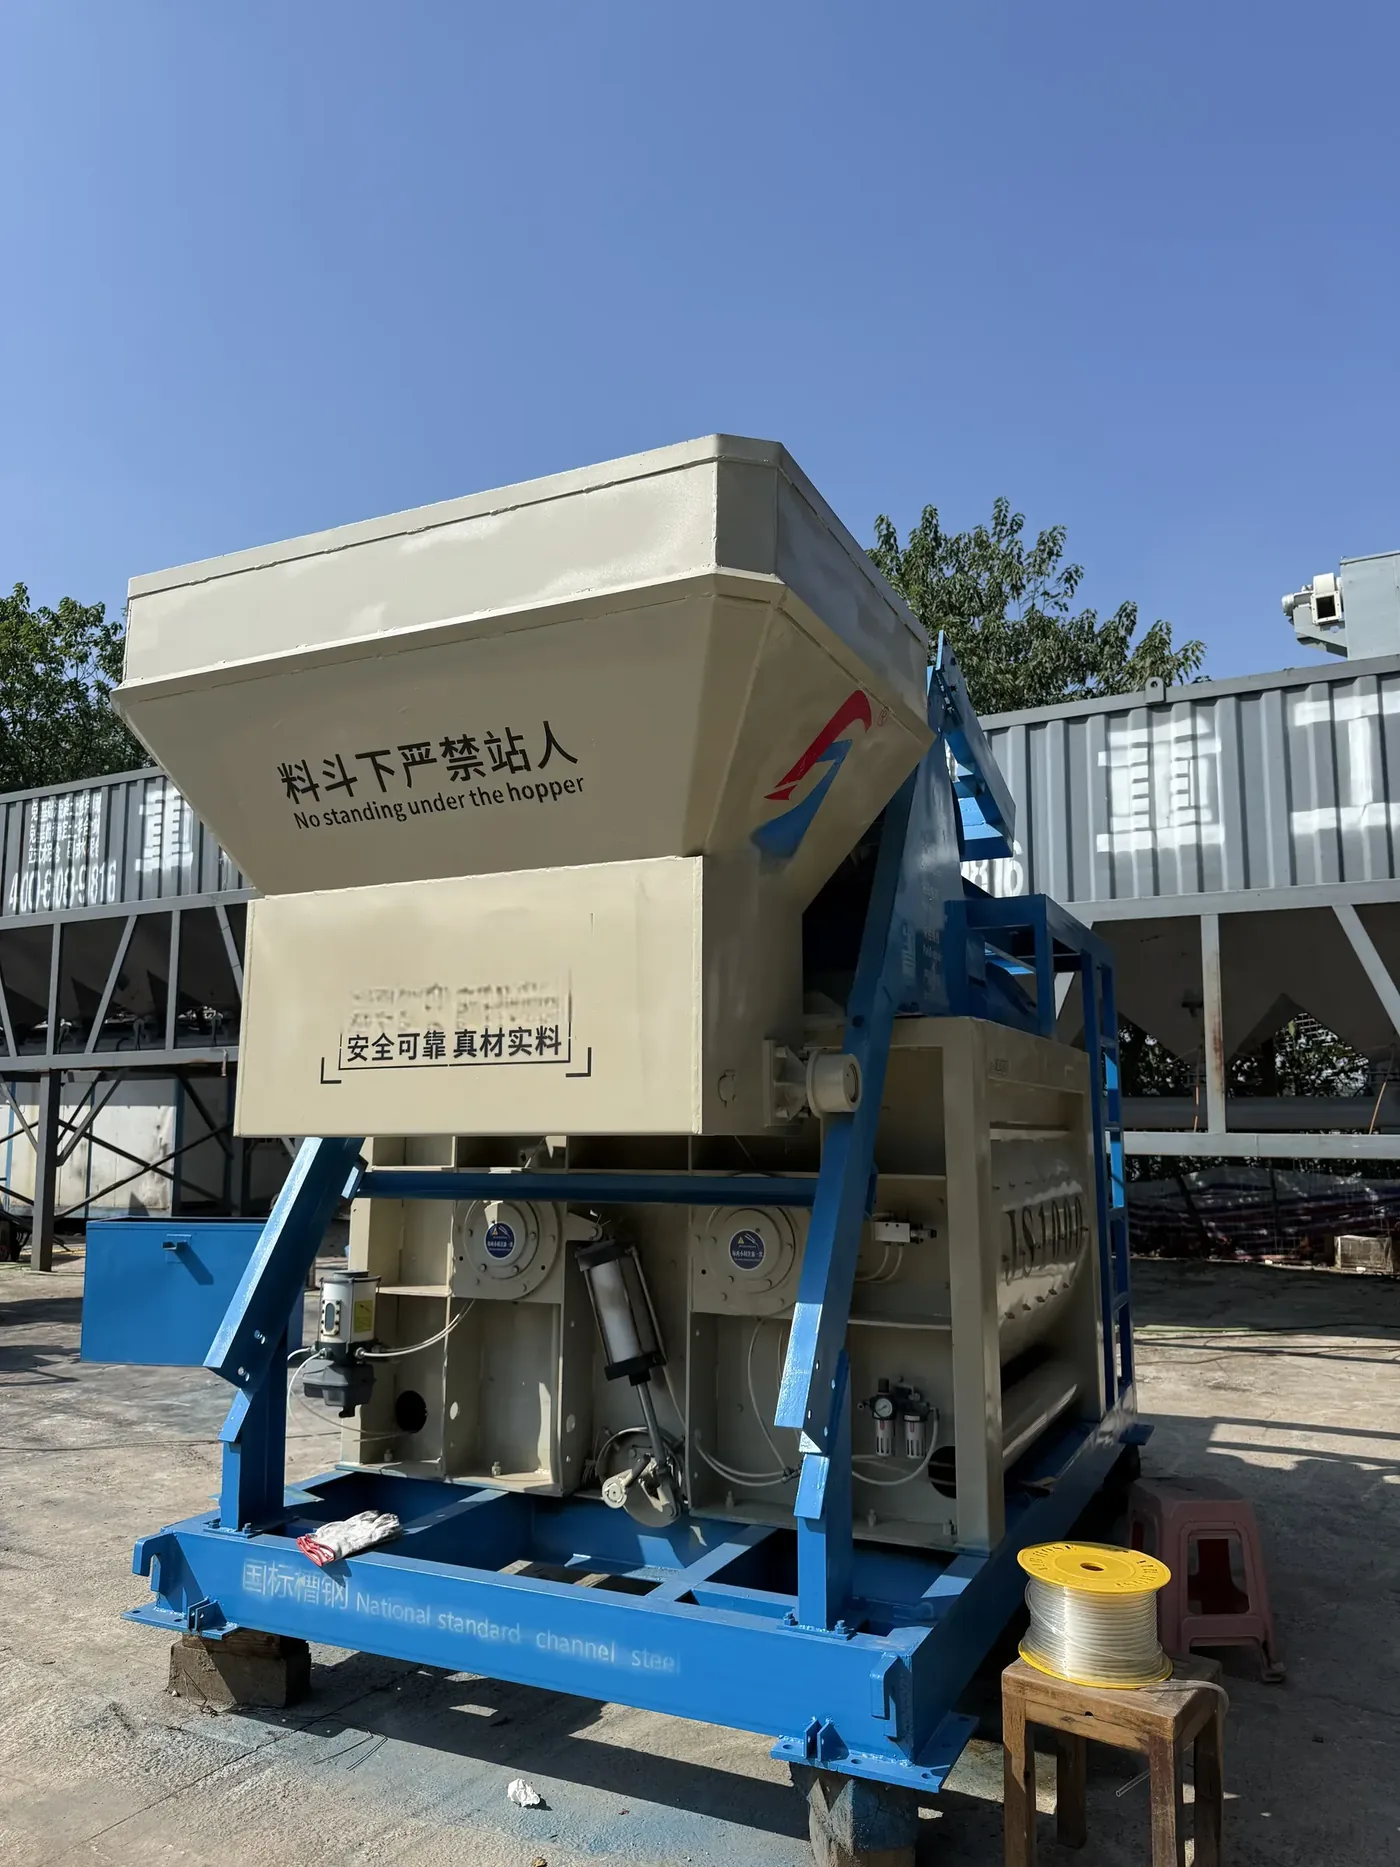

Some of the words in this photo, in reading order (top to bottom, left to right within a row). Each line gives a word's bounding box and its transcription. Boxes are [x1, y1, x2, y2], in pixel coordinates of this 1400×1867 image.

[277, 720, 578, 805] 料斗下严禁站人
[293, 811, 320, 829] No
[323, 801, 407, 827] standing
[408, 792, 465, 816] under
[469, 786, 504, 808] the
[506, 776, 585, 802] hopper
[347, 1030, 446, 1062] 安全可靠
[453, 1025, 562, 1059] 真材实料
[242, 1557, 349, 1610] 国标槽钢
[356, 1592, 430, 1626] National
[438, 1611, 520, 1643] standard
[536, 1630, 615, 1662] channel
[631, 1647, 681, 1674] steel
